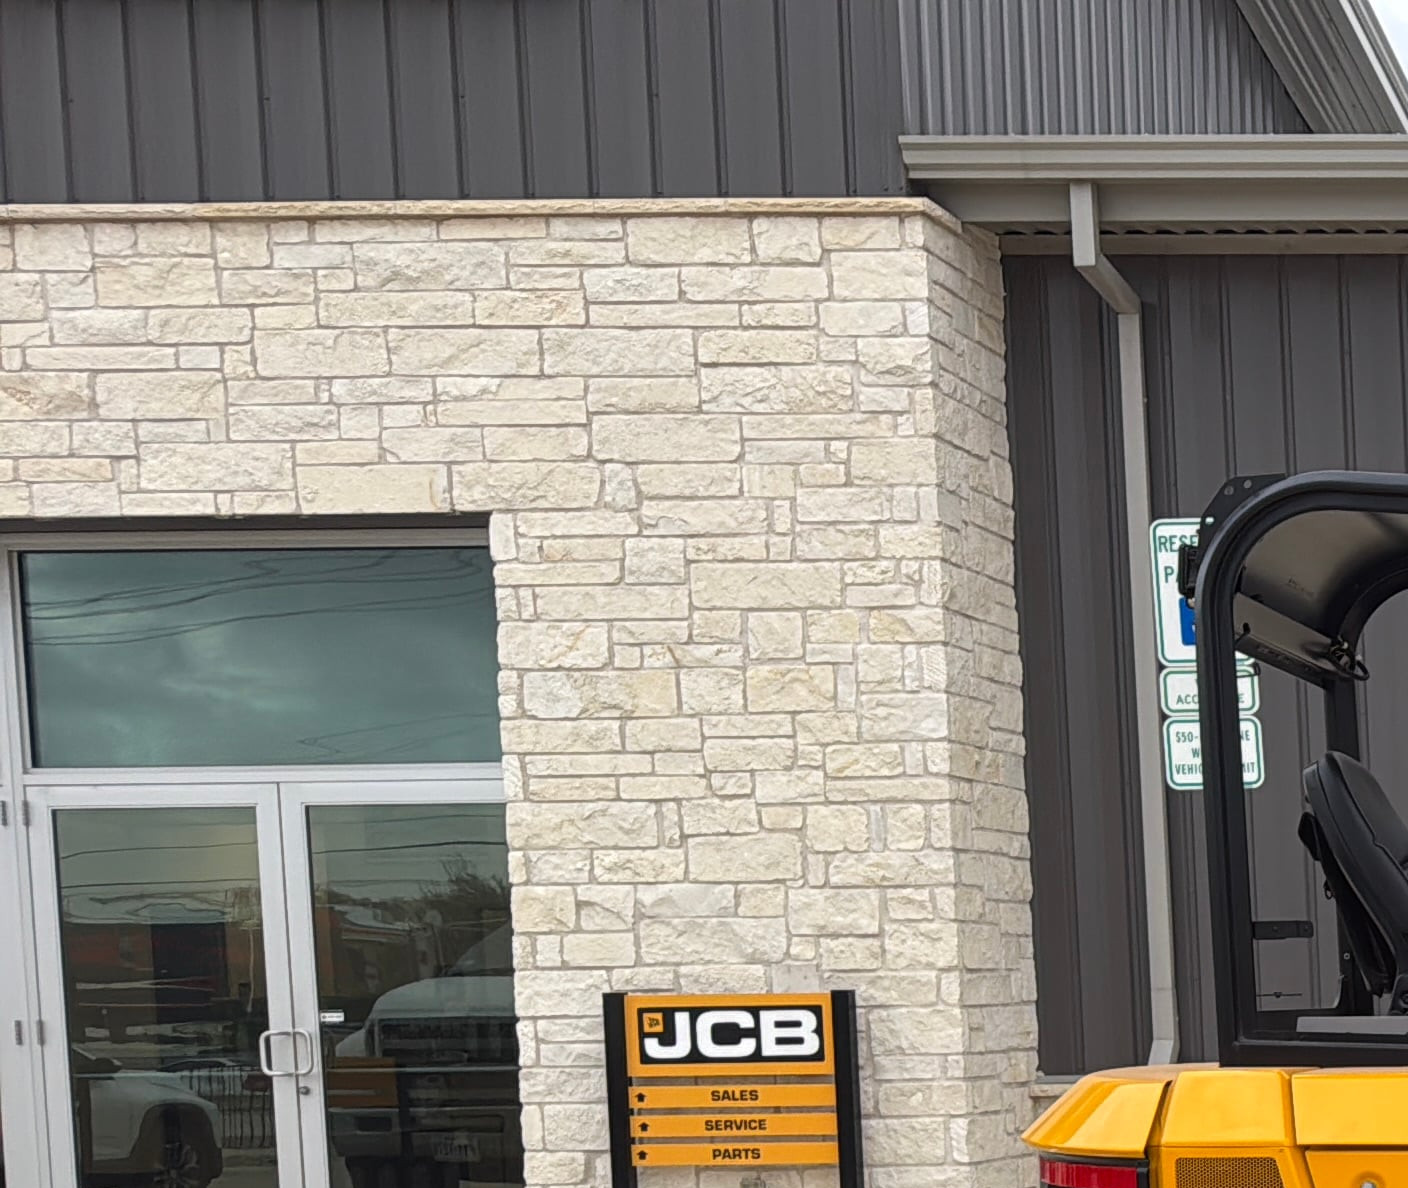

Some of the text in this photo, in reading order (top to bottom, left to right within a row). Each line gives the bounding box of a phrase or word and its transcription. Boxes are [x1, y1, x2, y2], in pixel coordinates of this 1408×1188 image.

[643, 1009, 821, 1060] JCB
[710, 1089, 759, 1102] SALES
[704, 1118, 767, 1131] SERVICE
[712, 1148, 761, 1160] PARTS
